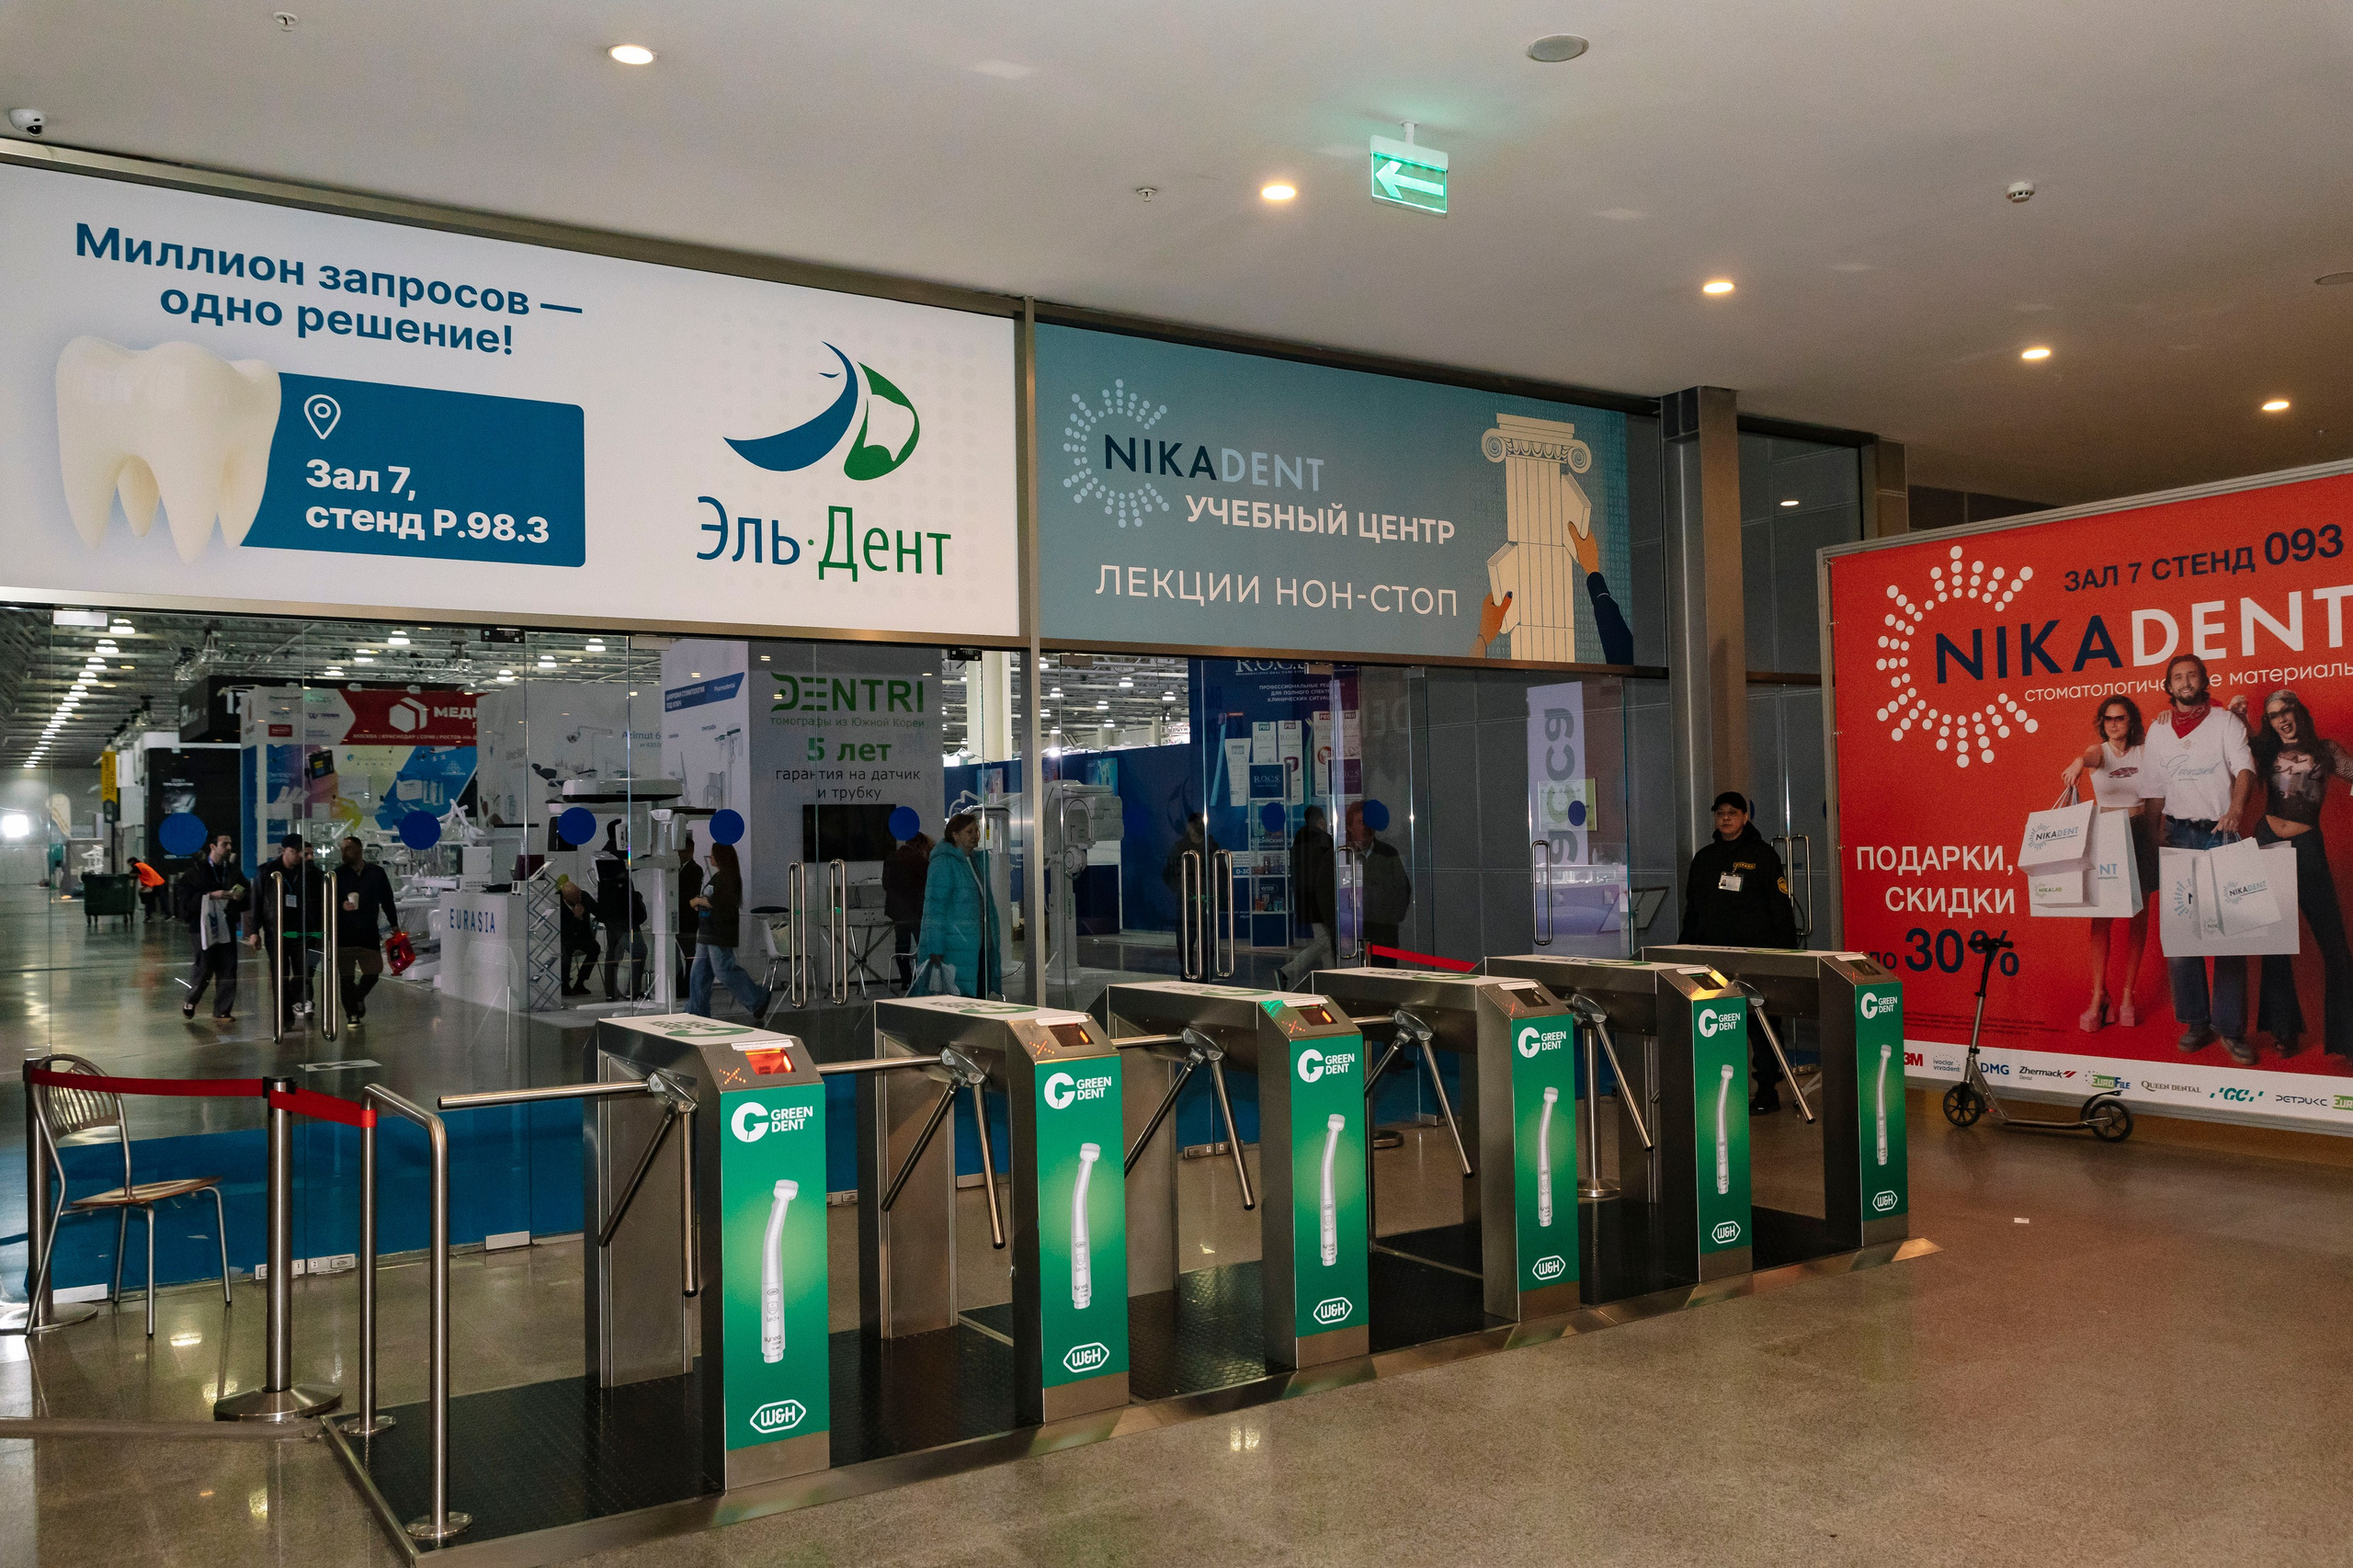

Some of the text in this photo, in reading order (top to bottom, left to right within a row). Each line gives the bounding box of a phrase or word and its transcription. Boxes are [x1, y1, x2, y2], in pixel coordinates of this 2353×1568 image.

[75, 223, 305, 286] Миллион
[318, 262, 530, 315] запросов
[160, 289, 514, 355] одно решение!
[1105, 434, 1324, 493] NIKADENT
[306, 459, 415, 501] Зал 7,
[306, 505, 426, 541] стенд
[1185, 494, 1456, 545] УЧЕБНЫЙ ЦЕНТР
[2064, 524, 2345, 592] ЗАЛ 7 СТЕНД 093
[1096, 564, 1458, 616] ЛЕКЦИИ НОН-СТОП
[1935, 585, 2353, 684] NIKADENT
[770, 671, 924, 712] DENTRI
[771, 717, 831, 728] томографы
[851, 717, 889, 727] Южной
[893, 719, 925, 728] Кореи
[807, 737, 892, 761] 5 лет
[776, 769, 921, 782] гарантия на датчик
[817, 786, 882, 801] и трубку
[2035, 827, 2079, 841] NIKADENT
[1856, 845, 2015, 877] ПОДАРКИ,
[2229, 880, 2267, 896] NIKADENT
[1885, 886, 2016, 920] СКИДКИ
[450, 908, 496, 935] EURASIA
[1904, 927, 2020, 976] 30%
[1878, 996, 1898, 1006] GREEN
[1878, 1004, 1894, 1014] DENT
[1718, 1013, 1741, 1022] GREEN
[1719, 1021, 1737, 1031] DENT
[1541, 1031, 1567, 1042] GREEN
[1541, 1040, 1563, 1051] DENT
[1324, 1053, 1356, 1065] GREEN
[1904, 1051, 1924, 1067] 3M
[1325, 1062, 1350, 1075] DENT
[1980, 1062, 2010, 1075] DMG
[2018, 1066, 2063, 1078] Zhermack
[1076, 1076, 1112, 1090] GREEN
[1077, 1087, 1106, 1101] DENT
[770, 1106, 813, 1121] GREEN
[771, 1118, 806, 1133] DENT
[1877, 1194, 1893, 1207] W&H
[1717, 1225, 1736, 1239] W&H
[1539, 1260, 1560, 1276] W&H
[1321, 1301, 1346, 1319] W&H
[1072, 1347, 1101, 1367] W&H
[761, 1405, 796, 1426] W&H
